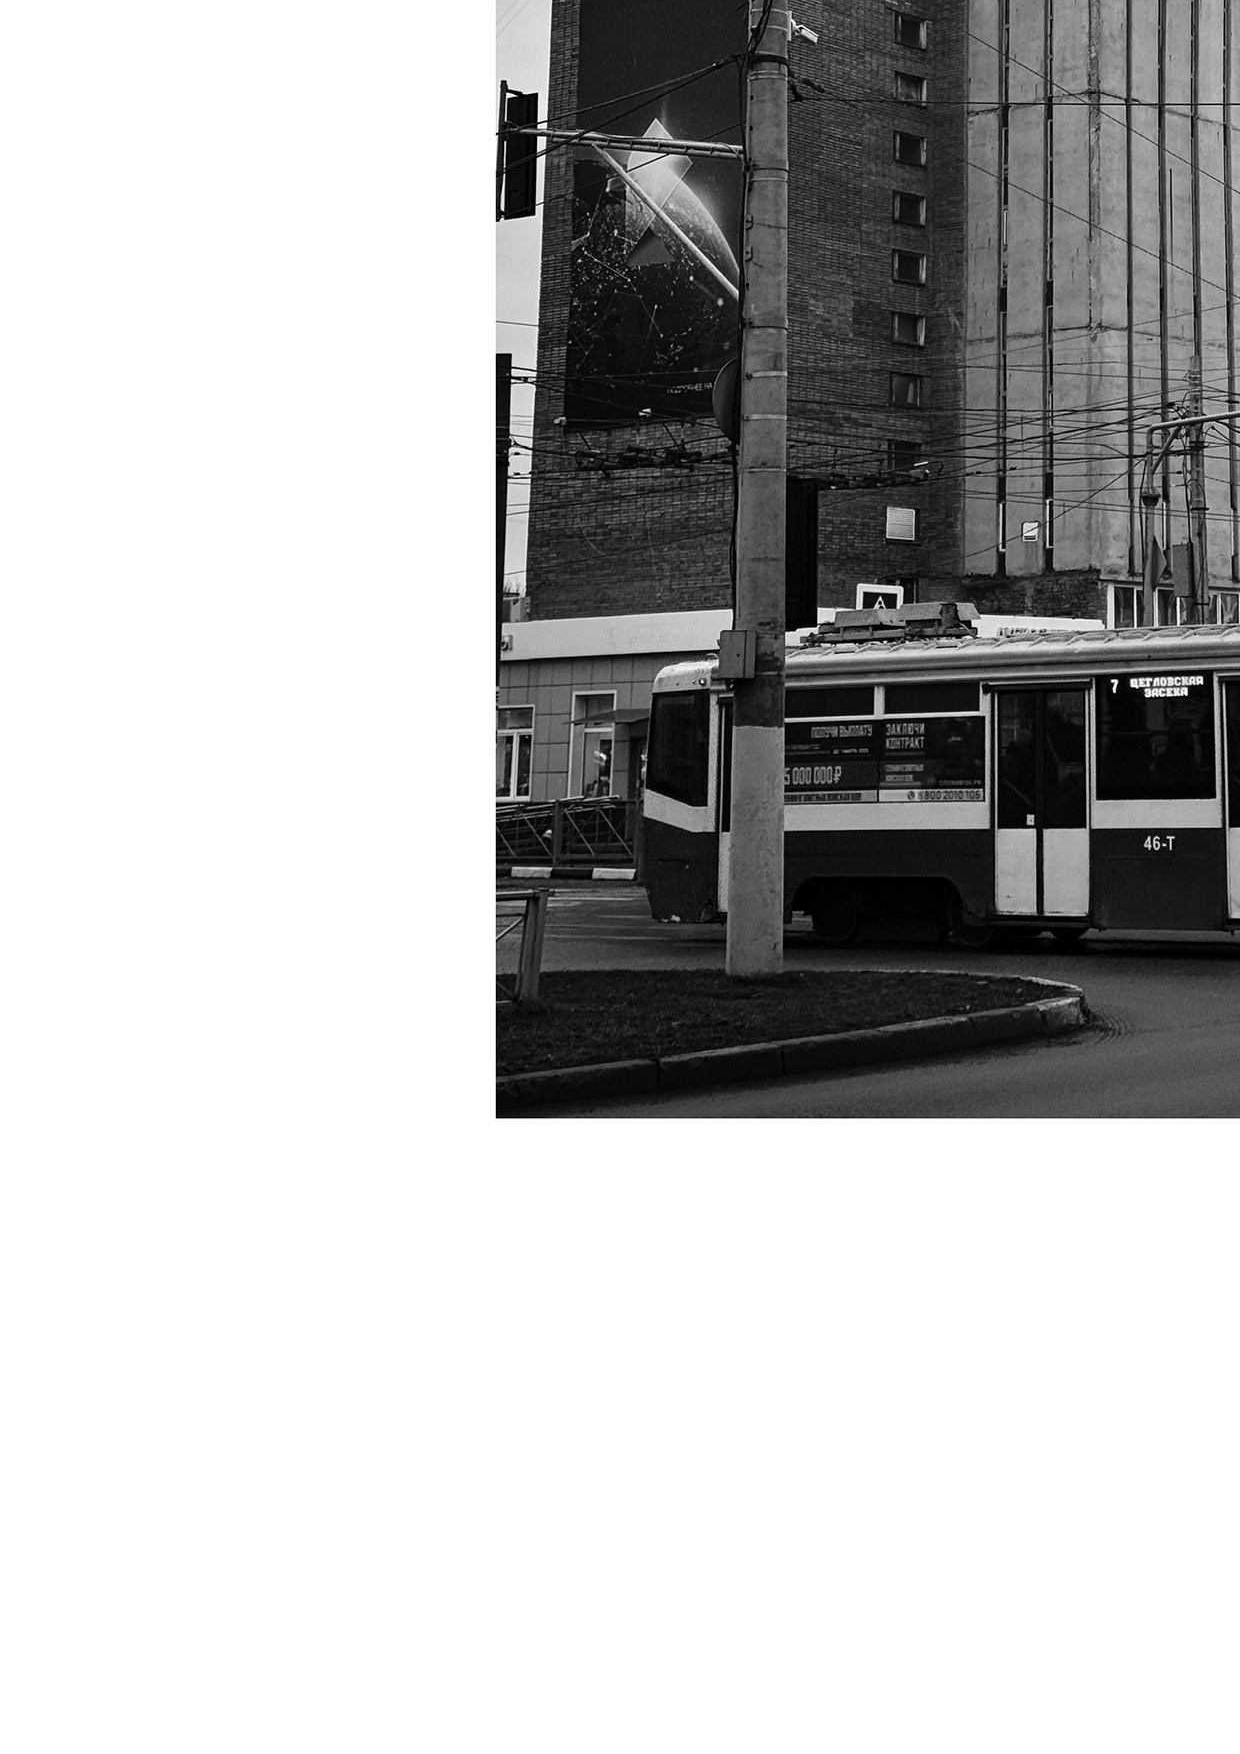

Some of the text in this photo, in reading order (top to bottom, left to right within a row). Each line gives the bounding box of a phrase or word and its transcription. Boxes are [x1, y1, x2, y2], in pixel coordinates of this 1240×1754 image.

[1110, 679, 1119, 694] 7
[1144, 687, 1188, 698] ЗАСЕКА
[886, 723, 925, 736] ЗАКЛЮЧИ
[886, 736, 925, 749] КОНТРАКТ
[1143, 835, 1176, 851] 46-Т
